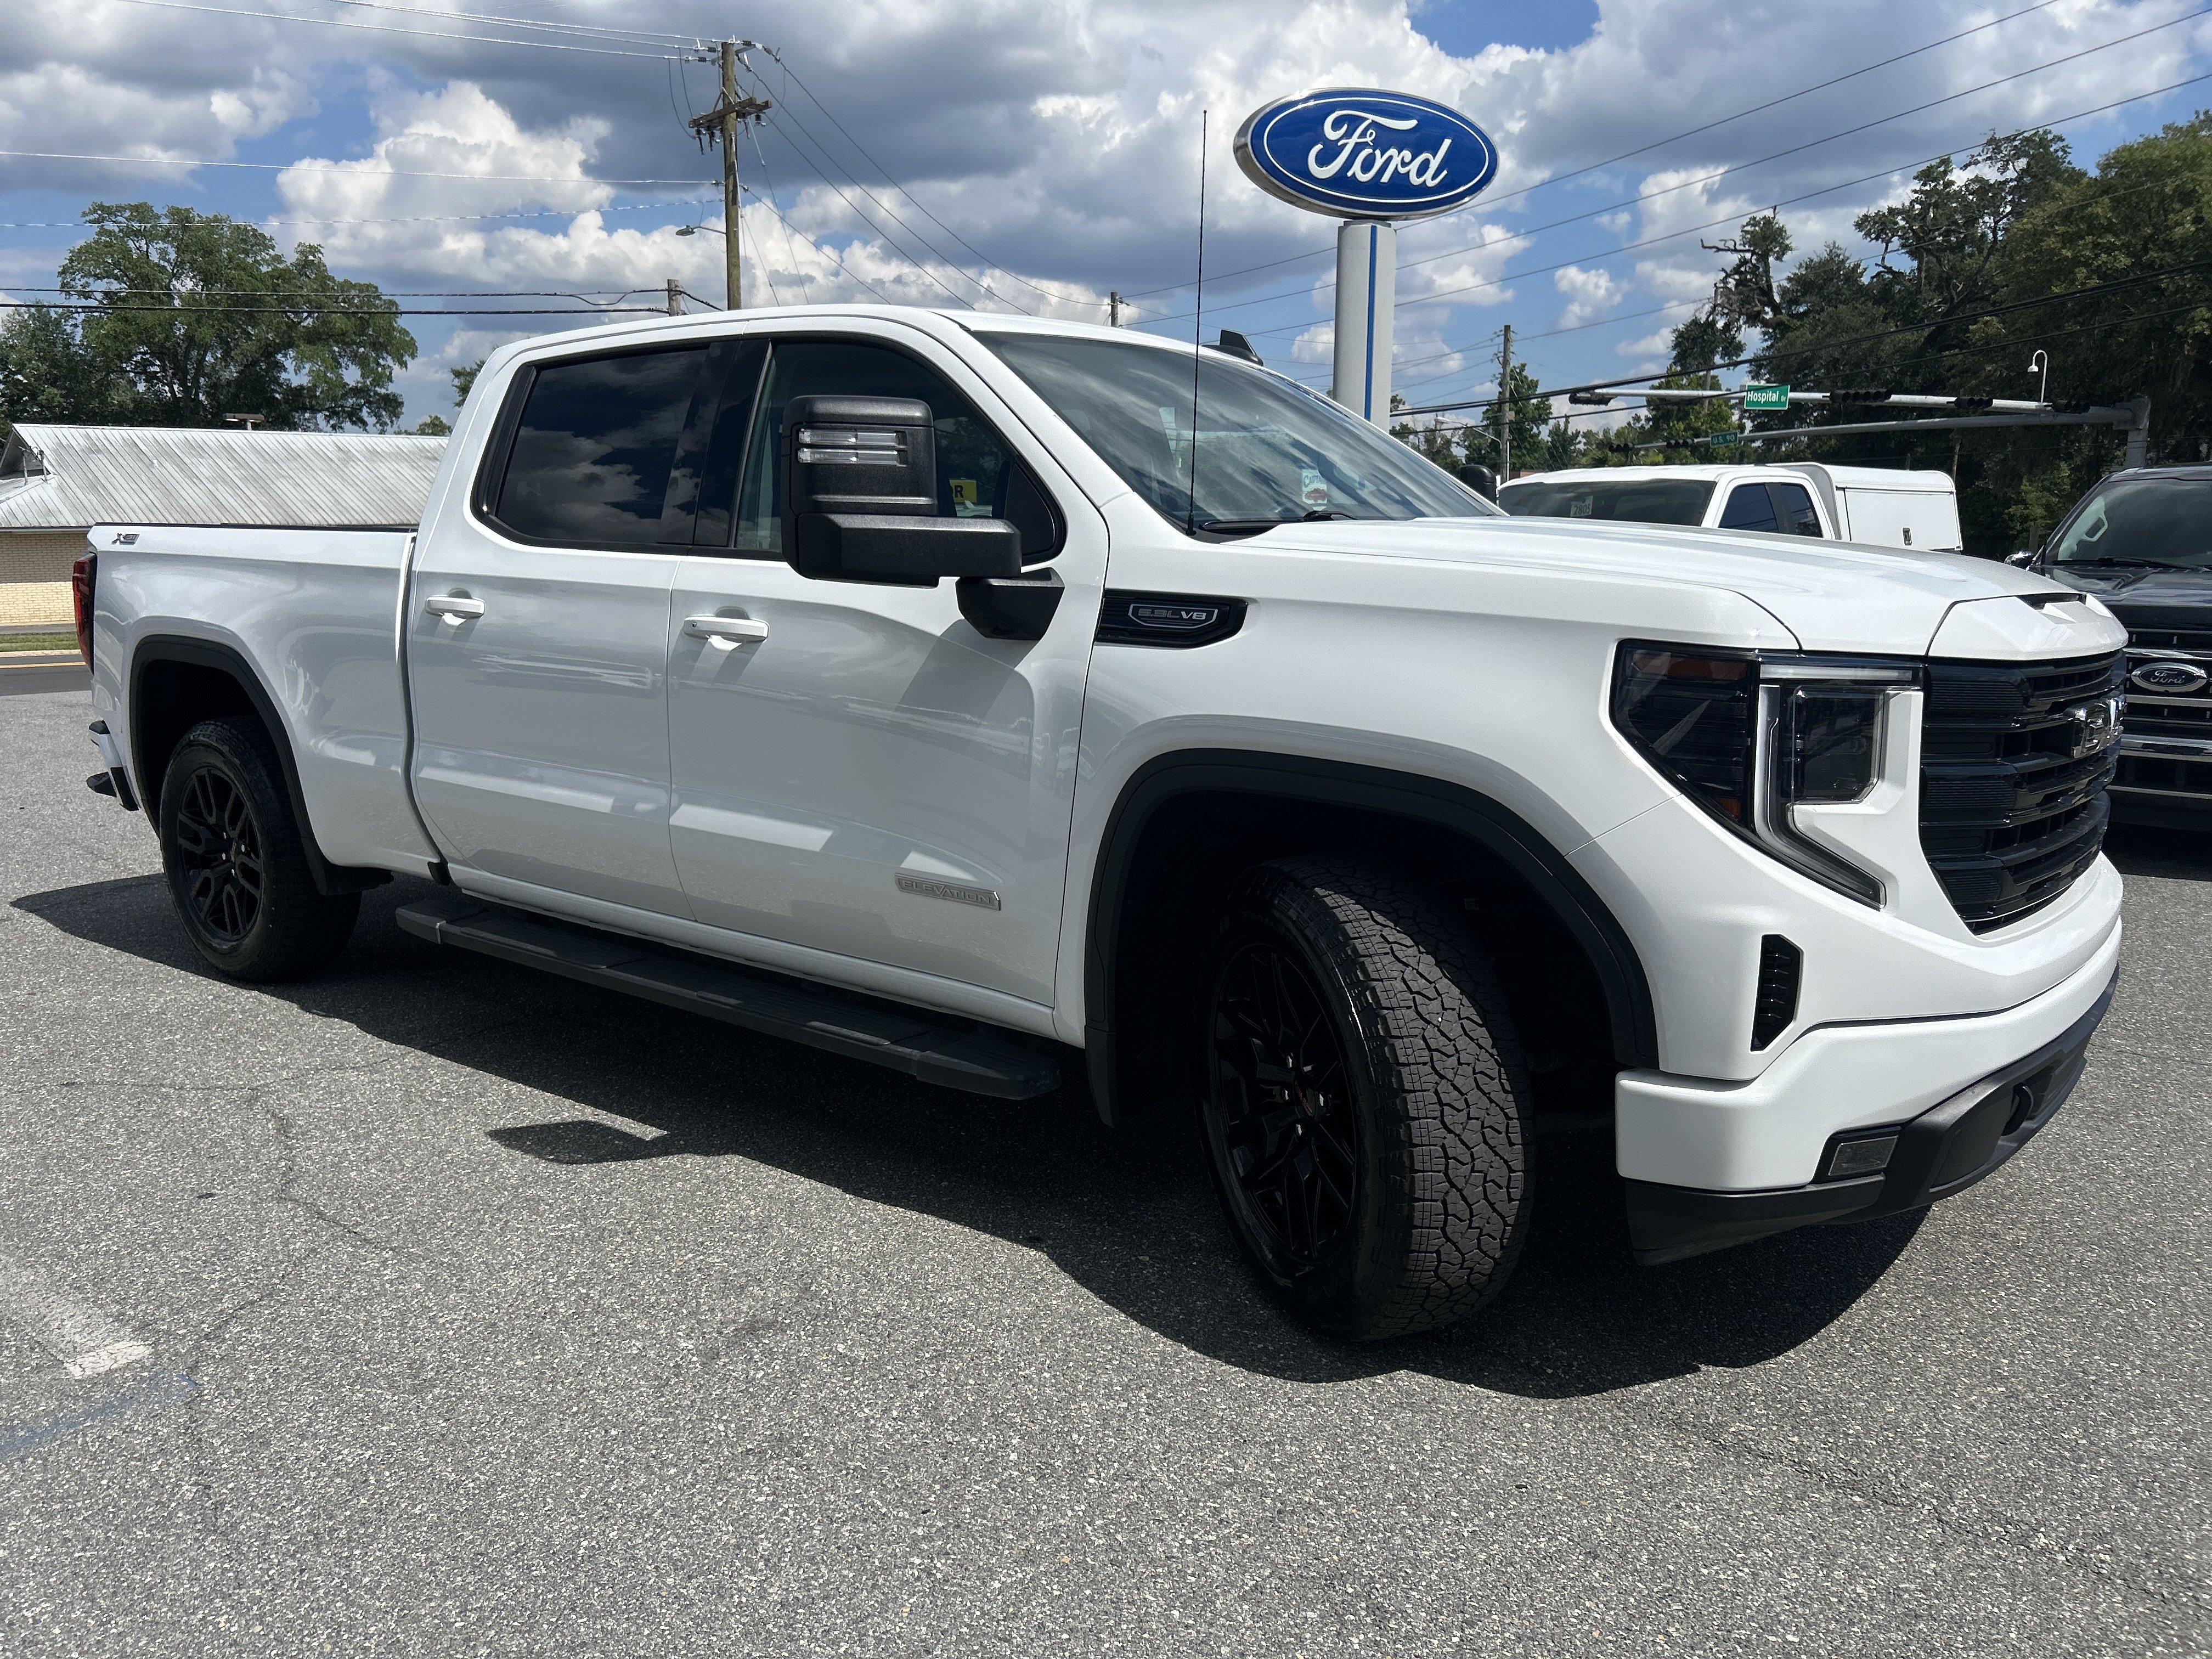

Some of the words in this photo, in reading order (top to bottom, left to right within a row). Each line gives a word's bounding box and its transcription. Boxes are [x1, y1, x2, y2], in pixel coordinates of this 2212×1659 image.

[1307, 110, 1453, 187] Ford
[1747, 391, 1779, 404] Hospital
[1573, 504, 1590, 515] 2805
[2151, 670, 2186, 684] Ford
[902, 879, 992, 904] ELEVATION
